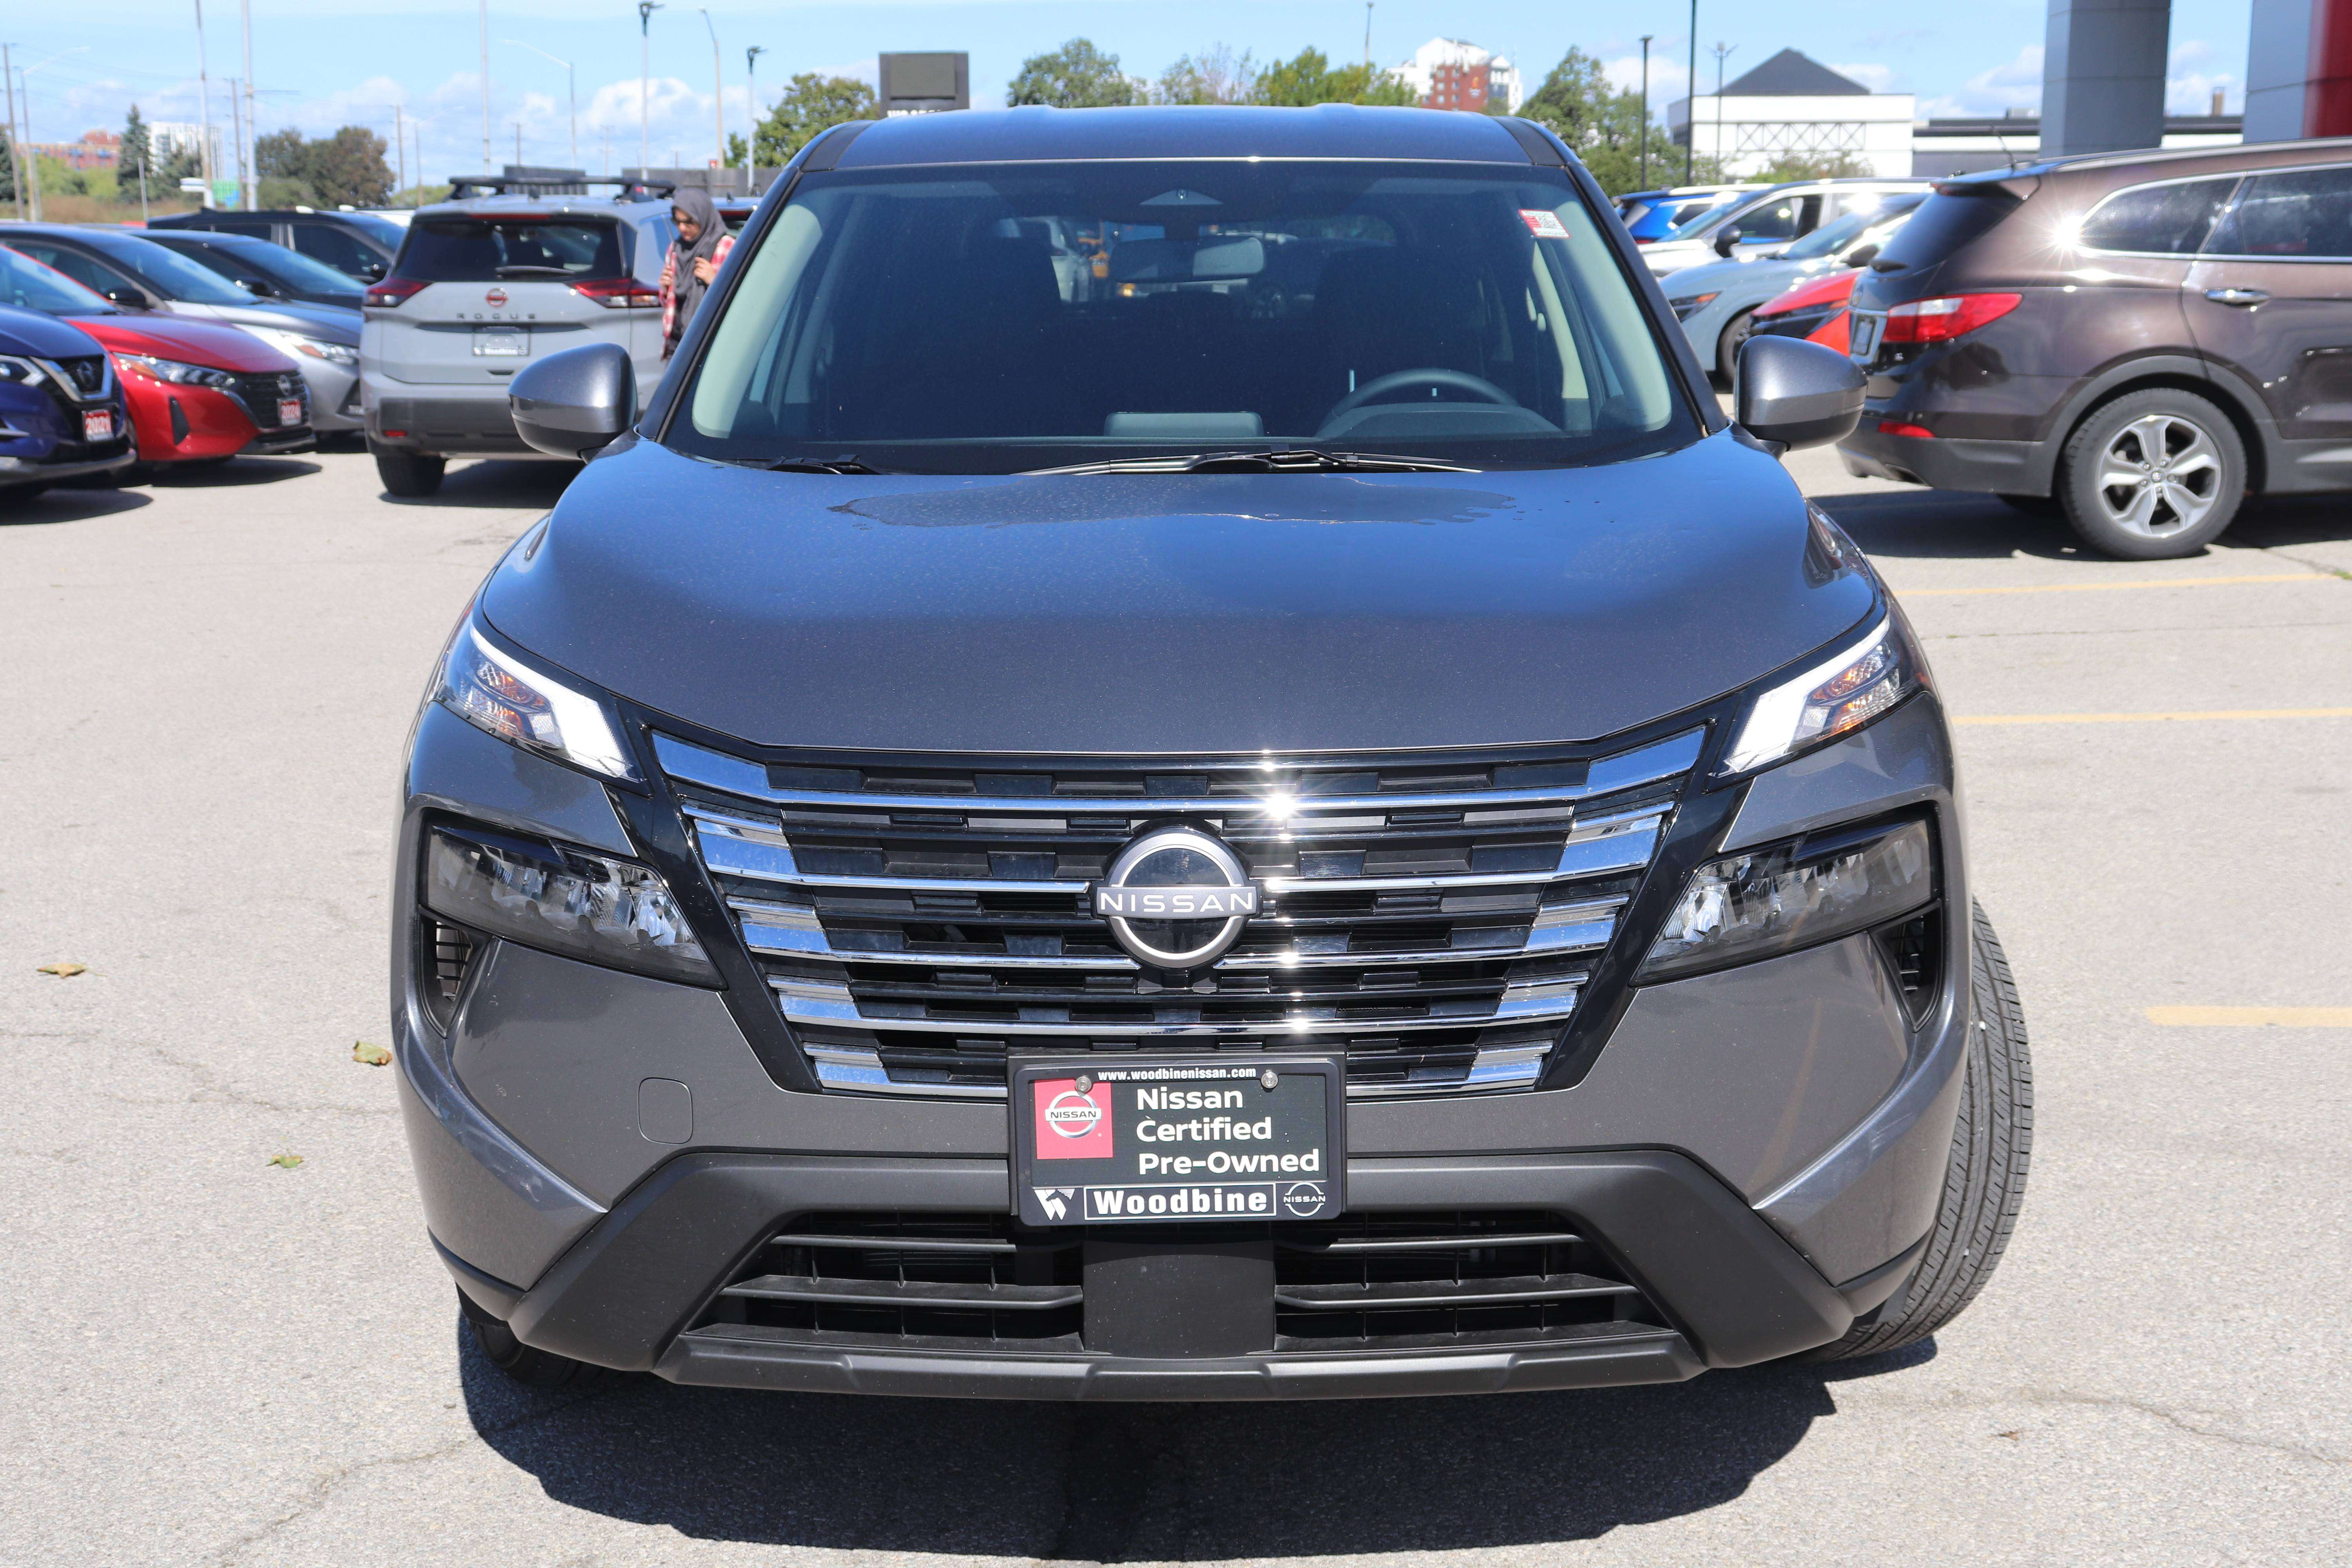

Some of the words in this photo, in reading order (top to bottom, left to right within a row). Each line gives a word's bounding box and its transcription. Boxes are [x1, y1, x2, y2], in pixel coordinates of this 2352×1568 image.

[1101, 892, 1252, 912] NISSAN
[1098, 1067, 1256, 1081] www.woodbinenissan.com
[1137, 1086, 1243, 1110] Nissan
[1136, 1117, 1272, 1142] Certified
[1139, 1149, 1319, 1175] Pre-Owned
[1093, 1189, 1267, 1214] Woodbine
